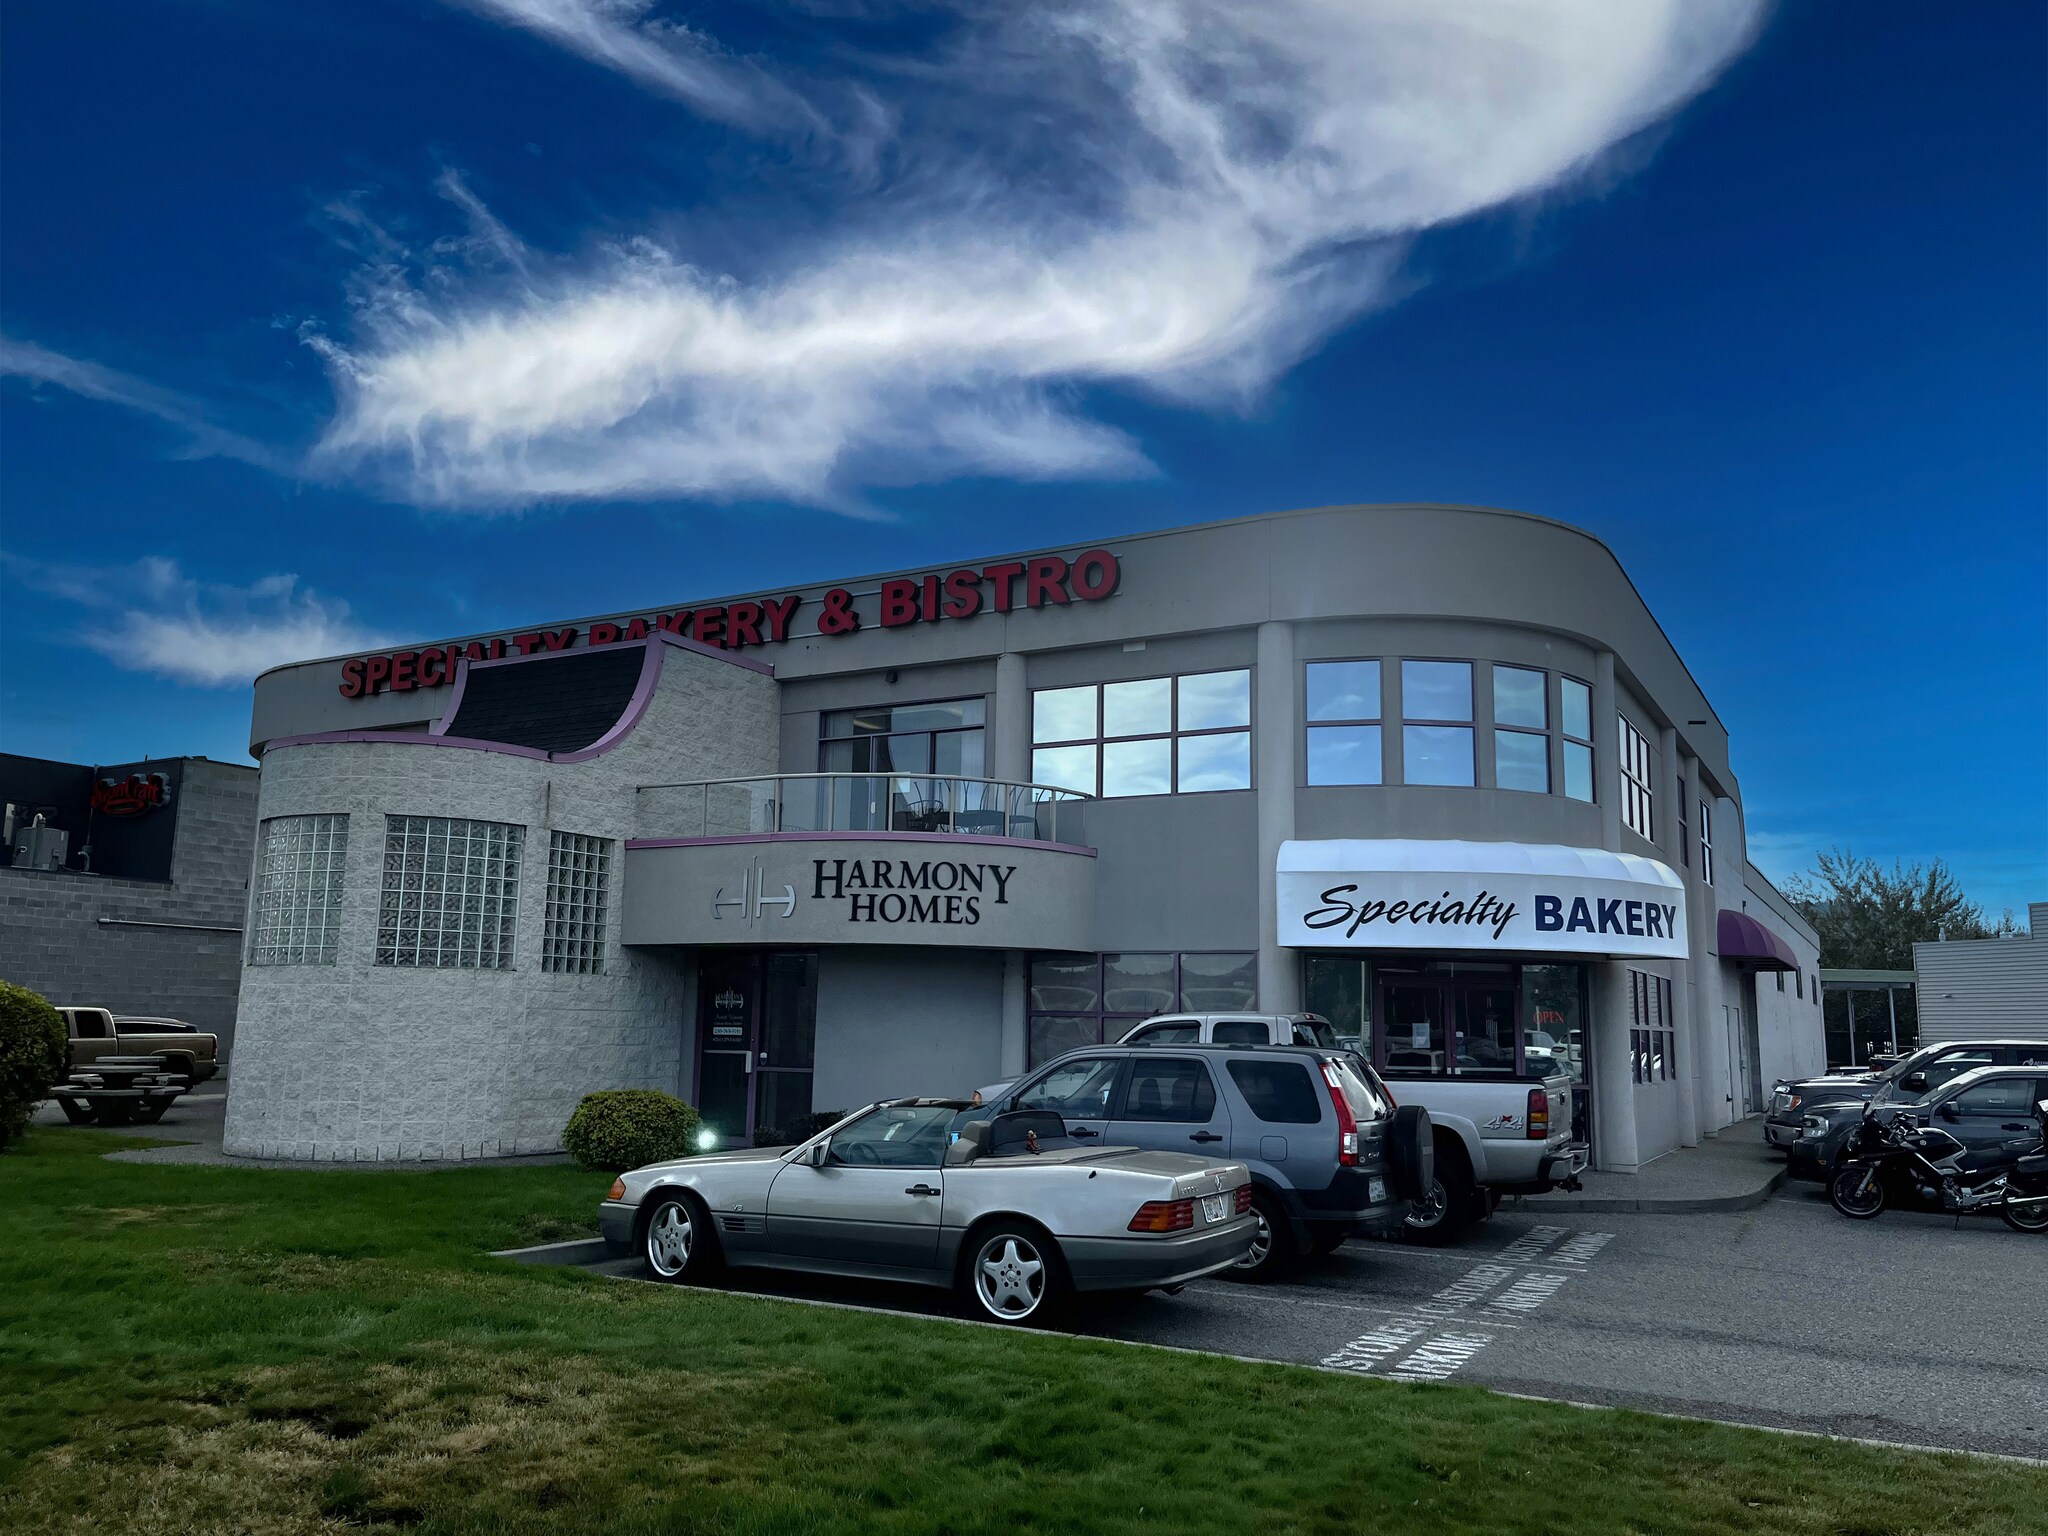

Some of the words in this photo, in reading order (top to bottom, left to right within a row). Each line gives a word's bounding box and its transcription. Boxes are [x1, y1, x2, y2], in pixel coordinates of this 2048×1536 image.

[817, 588, 860, 635] &
[881, 549, 1121, 627] BISTRO
[811, 859, 1017, 904] HARMONY
[848, 893, 980, 925] HOMES
[1303, 884, 1520, 940] Specialty
[1534, 894, 1678, 940] BAKERY
[1532, 1009, 1565, 1025] OPEN
[1413, 1264, 1517, 1314] CUSTOMER
[1478, 1273, 1569, 1319] PARKING
